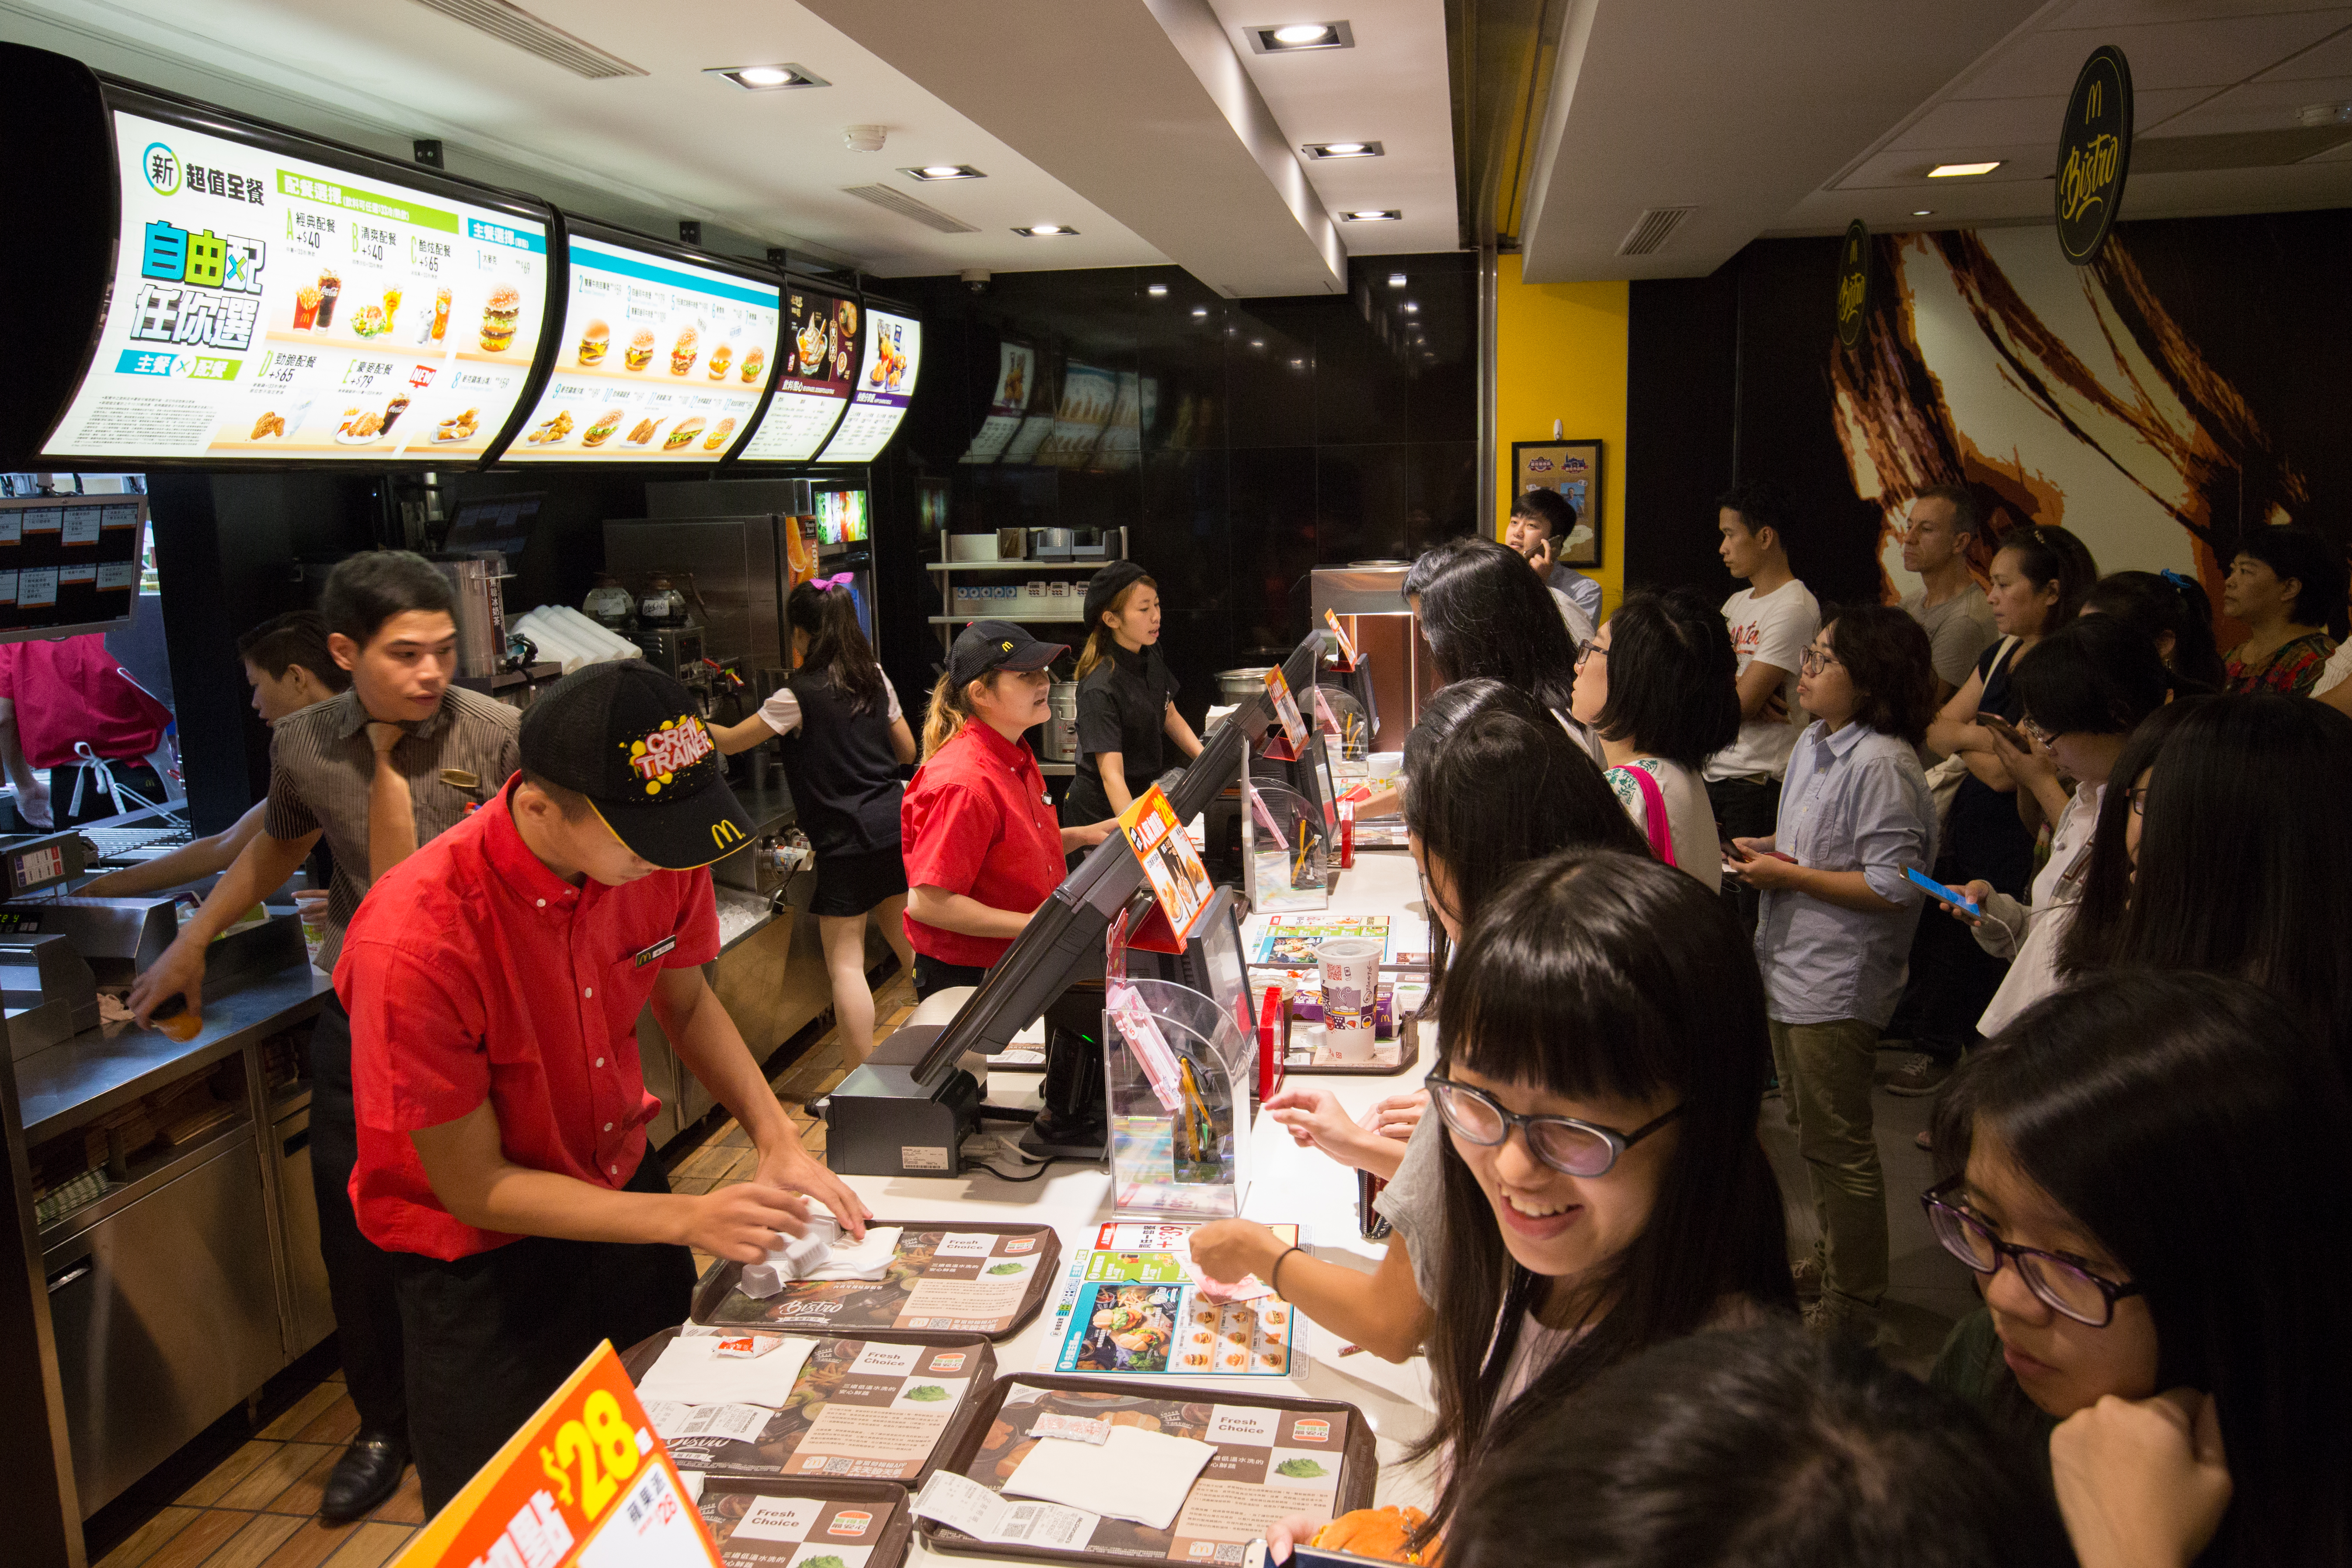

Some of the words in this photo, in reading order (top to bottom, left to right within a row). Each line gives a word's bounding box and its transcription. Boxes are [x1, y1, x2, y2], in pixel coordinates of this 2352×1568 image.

[152, 154, 174, 186] 新
[186, 163, 264, 206] 超值全餐
[2061, 134, 2118, 220] Bistro
[284, 175, 342, 205] 配餐選擇
[287, 208, 293, 240] A
[296, 212, 335, 233] 經典配餐
[296, 230, 320, 248] +$40
[352, 222, 358, 252] B
[362, 226, 396, 246] 清爽配餐
[473, 223, 515, 245] 主餐選擇
[362, 244, 383, 261] +$40
[411, 236, 417, 264] C
[419, 239, 451, 257] 酷炫配餐
[142, 220, 266, 296] 自由配
[419, 256, 438, 272] +$65
[477, 250, 480, 269] 1
[483, 254, 497, 265] 大麥克
[579, 275, 583, 292] 2
[627, 285, 631, 302] 3
[1839, 272, 1865, 322] Bistro
[671, 295, 675, 310] 5
[712, 303, 716, 318] 6
[130, 283, 260, 351] 任你選
[626, 305, 630, 321] 4
[746, 310, 748, 325] 7
[134, 354, 172, 374] 主餐
[193, 359, 229, 379] 配餐
[257, 350, 274, 377] D
[275, 353, 317, 368] 勁脆配餐
[356, 361, 393, 375] 豪麥配餐
[269, 368, 295, 382] +$65
[351, 375, 373, 388] +$79
[411, 368, 435, 386] NEW
[452, 372, 463, 389] 8
[552, 384, 562, 399] 9
[645, 716, 699, 754] CREW
[634, 730, 713, 780] TRAINER
[1137, 810, 1166, 850] 人氣加點
[1129, 1028, 1136, 1036] 5
[779, 1300, 843, 1315] Bistro
[864, 1358, 905, 1366] Choice
[842, 1384, 897, 1392] 三道低溫水洗的
[740, 1412, 758, 1433] McDonald's
[1218, 1424, 1264, 1434] Choice
[1220, 1417, 1256, 1425] Fresh
[855, 1460, 908, 1468] 麥當勞報報APP
[1213, 1456, 1264, 1465] 道低溫水洗的
[625, 1472, 665, 1526] 蘋果派
[751, 1517, 800, 1527] Choice
[756, 1509, 796, 1518] Fresh
[1065, 1516, 1083, 1544] McDonald's
